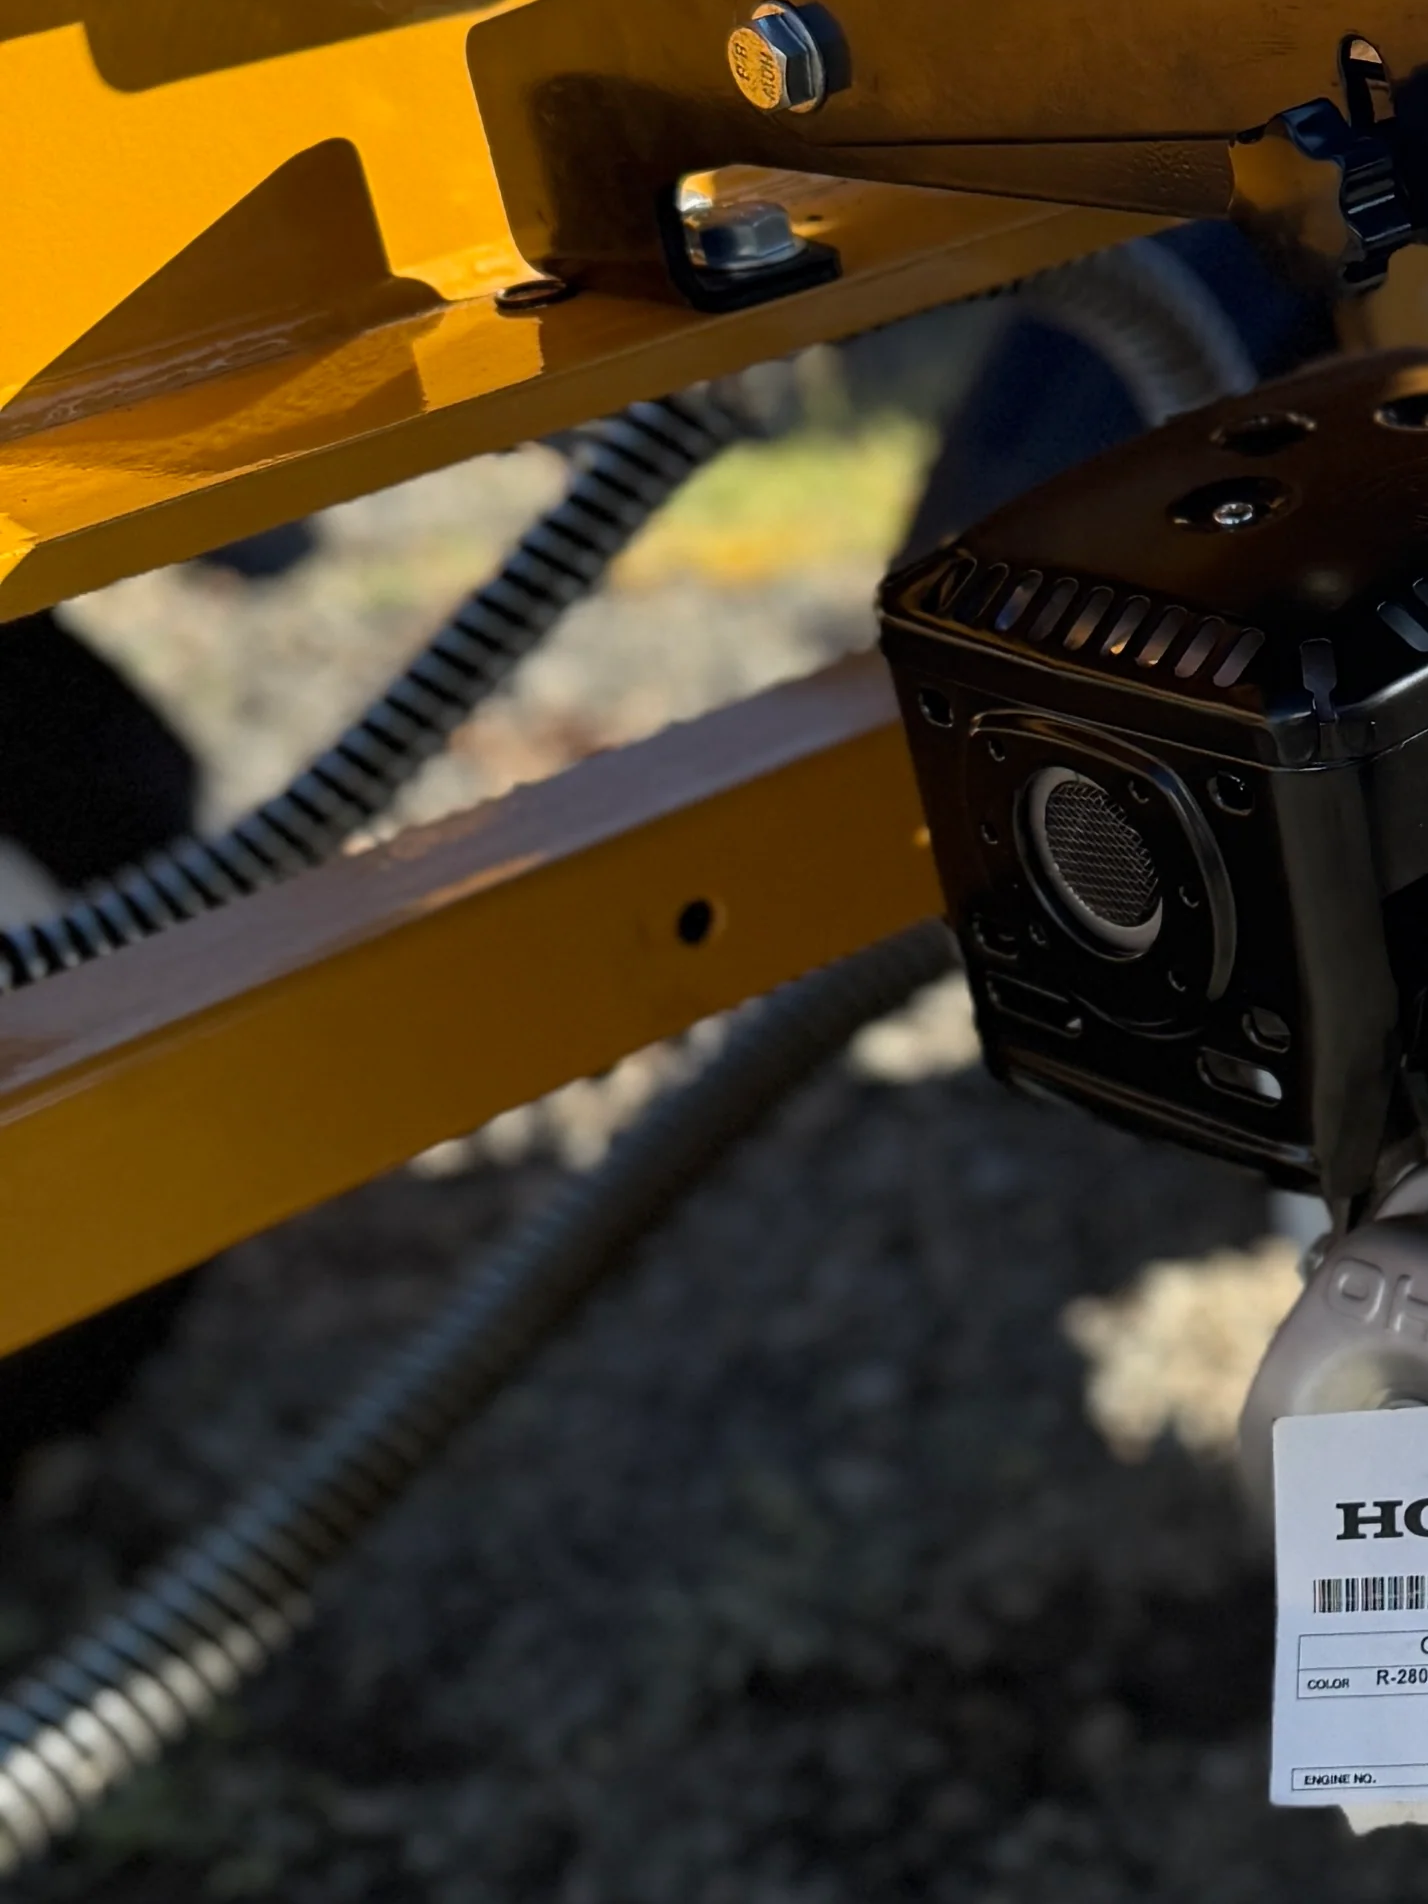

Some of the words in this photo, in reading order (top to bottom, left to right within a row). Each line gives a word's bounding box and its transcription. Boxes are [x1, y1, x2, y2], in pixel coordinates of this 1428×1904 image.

[1307, 1678, 1350, 1690] COLOR
[1376, 1668, 1428, 1686] R-280
[1304, 1773, 1351, 1786] ENGINE
[1354, 1772, 1377, 1784] NO.
